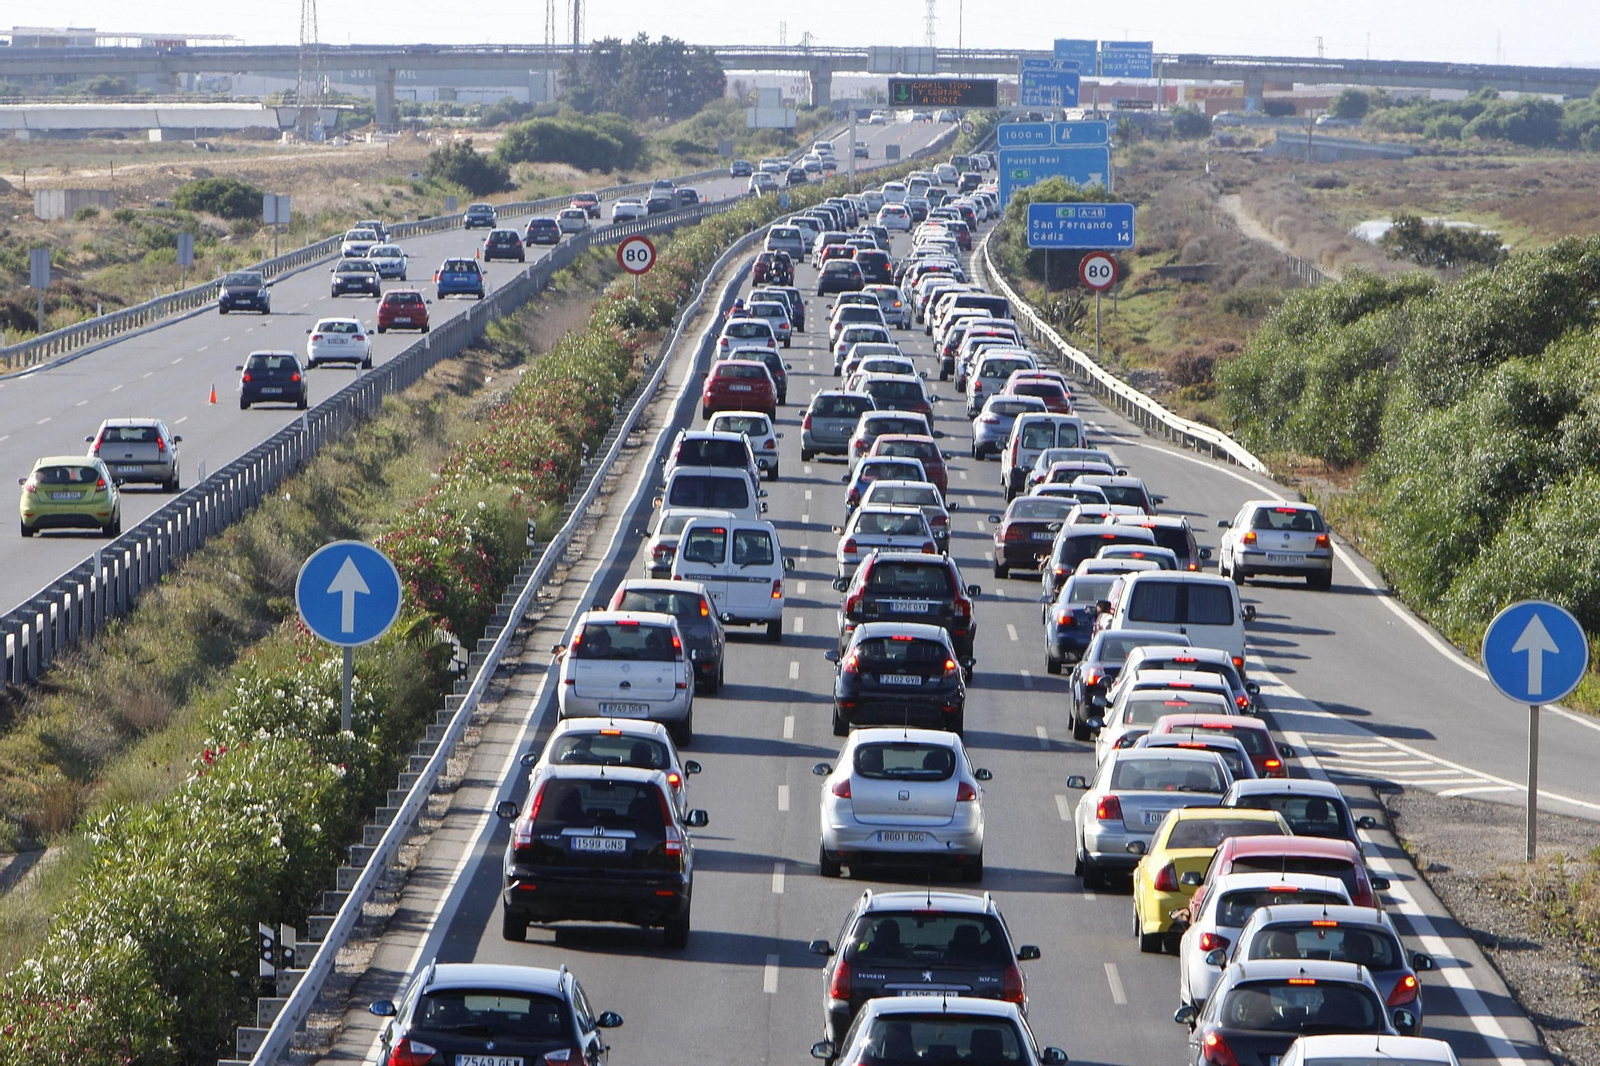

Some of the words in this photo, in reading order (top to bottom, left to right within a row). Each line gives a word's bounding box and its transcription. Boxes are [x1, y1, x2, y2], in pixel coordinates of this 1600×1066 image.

[1193, 88, 1234, 99] DHL
[1006, 131, 1032, 139] 1000
[1007, 157, 1037, 165] Puerto
[1039, 155, 1060, 164] Real
[1033, 220, 1053, 229] San
[1059, 220, 1113, 230] Fernando
[1122, 220, 1129, 229] 5
[1033, 231, 1064, 241] Cádiz
[1117, 232, 1130, 242] 14
[626, 249, 648, 262] 80
[1088, 265, 1110, 278] 80
[884, 832, 905, 841] 8601
[578, 837, 601, 850] 1599
[604, 838, 623, 850] GNS
